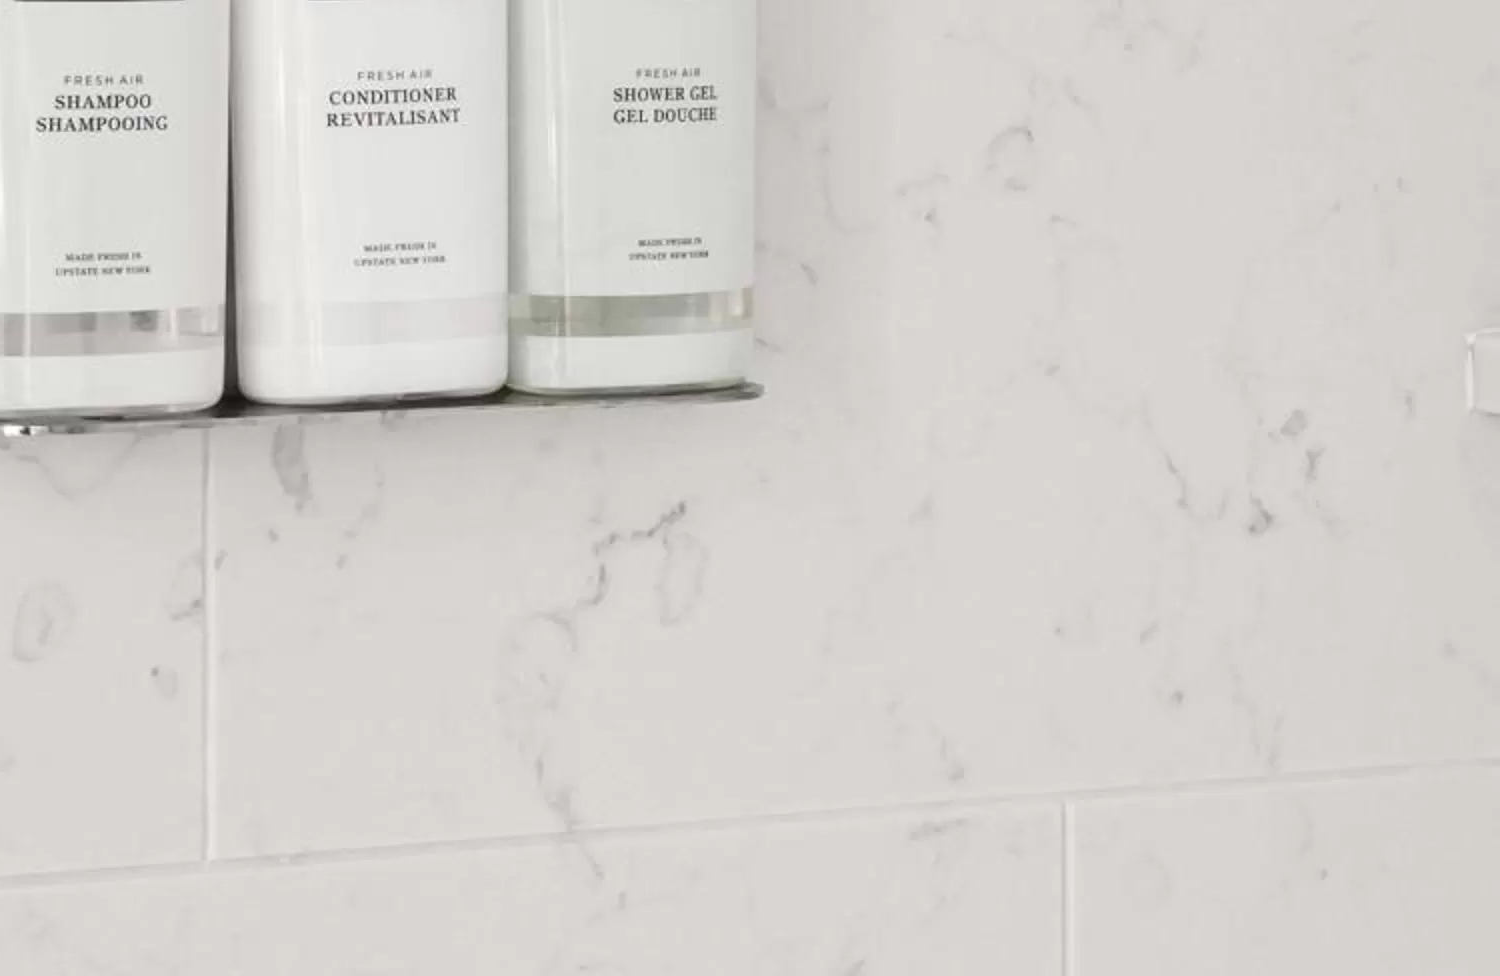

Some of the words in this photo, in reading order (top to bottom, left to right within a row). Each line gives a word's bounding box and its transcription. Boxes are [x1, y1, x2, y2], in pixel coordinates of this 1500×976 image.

[63, 74, 114, 86] FRESH
[119, 74, 144, 85] AIR
[357, 70, 405, 81] FRESH
[409, 68, 433, 79] AIR
[53, 93, 152, 110] SHAMPOO
[328, 86, 457, 106] CONDITIONER
[612, 86, 685, 102] SHOWER
[689, 84, 718, 101] GEL
[35, 115, 169, 133] SHAMPOOING
[326, 107, 461, 128] REVITALISANT
[613, 108, 649, 124] GEL
[653, 106, 717, 124] DOUCHE
